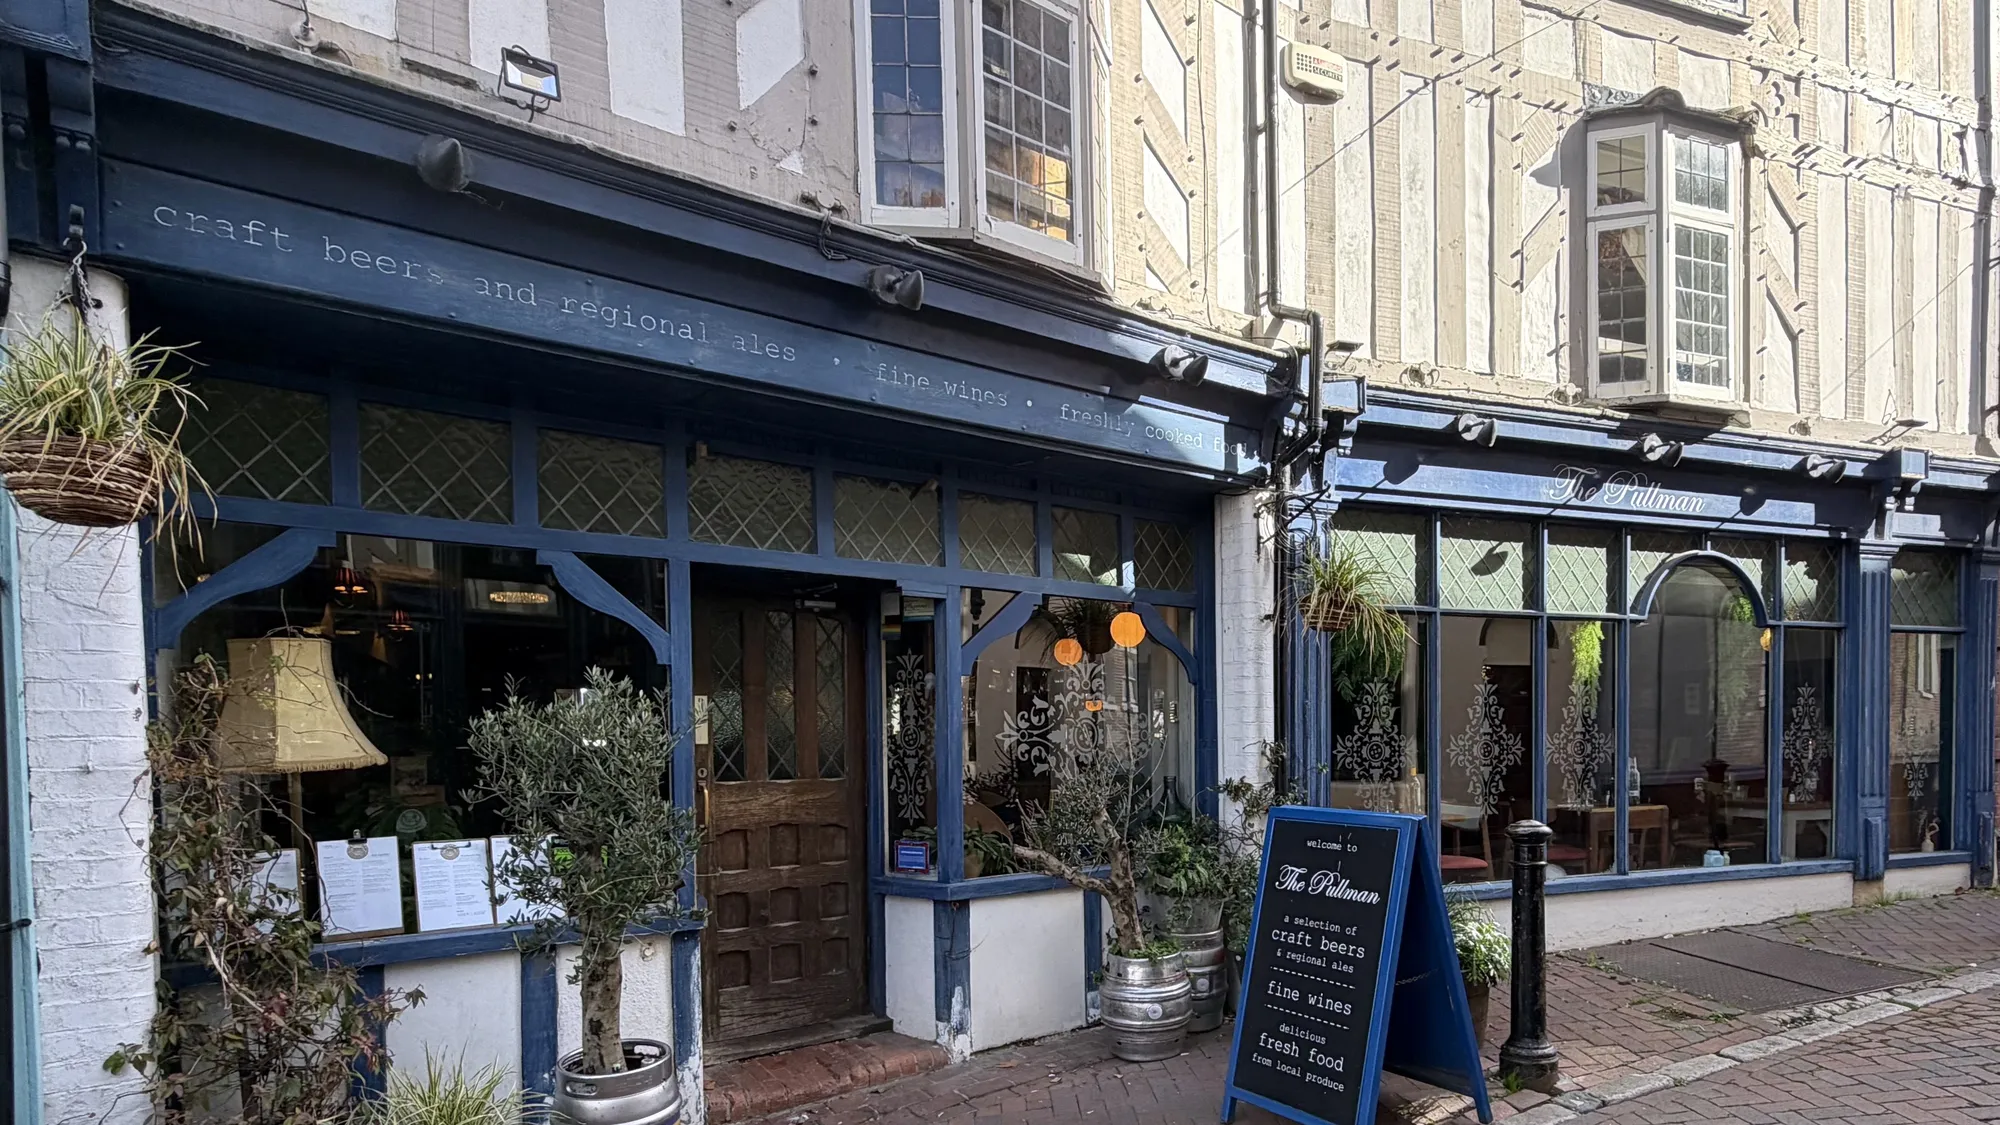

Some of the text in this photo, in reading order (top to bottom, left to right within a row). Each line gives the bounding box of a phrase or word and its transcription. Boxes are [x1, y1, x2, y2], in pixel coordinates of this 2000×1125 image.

[1313, 66, 1342, 82] SECURITY
[153, 205, 292, 253] craft
[322, 236, 444, 286] beers
[474, 276, 537, 307] and
[561, 294, 710, 344] regional
[732, 333, 796, 362] ales
[876, 363, 930, 390] fine
[943, 381, 1008, 407] wines
[1060, 404, 1135, 437] freshly
[1145, 425, 1203, 448] cooked
[1549, 463, 1706, 513] The Pullman
[1307, 839, 1357, 852] welcome to
[1275, 864, 1380, 904] The Pullman
[1284, 915, 1357, 936] a selection of
[1271, 929, 1365, 958] craft beers
[1286, 951, 1326, 967] regional
[1332, 961, 1354, 973] ales
[1267, 981, 1352, 1015] fine wines
[1279, 1023, 1327, 1045] delicious
[1259, 1033, 1344, 1072] fresh food
[1252, 1053, 1345, 1092] from local produce
